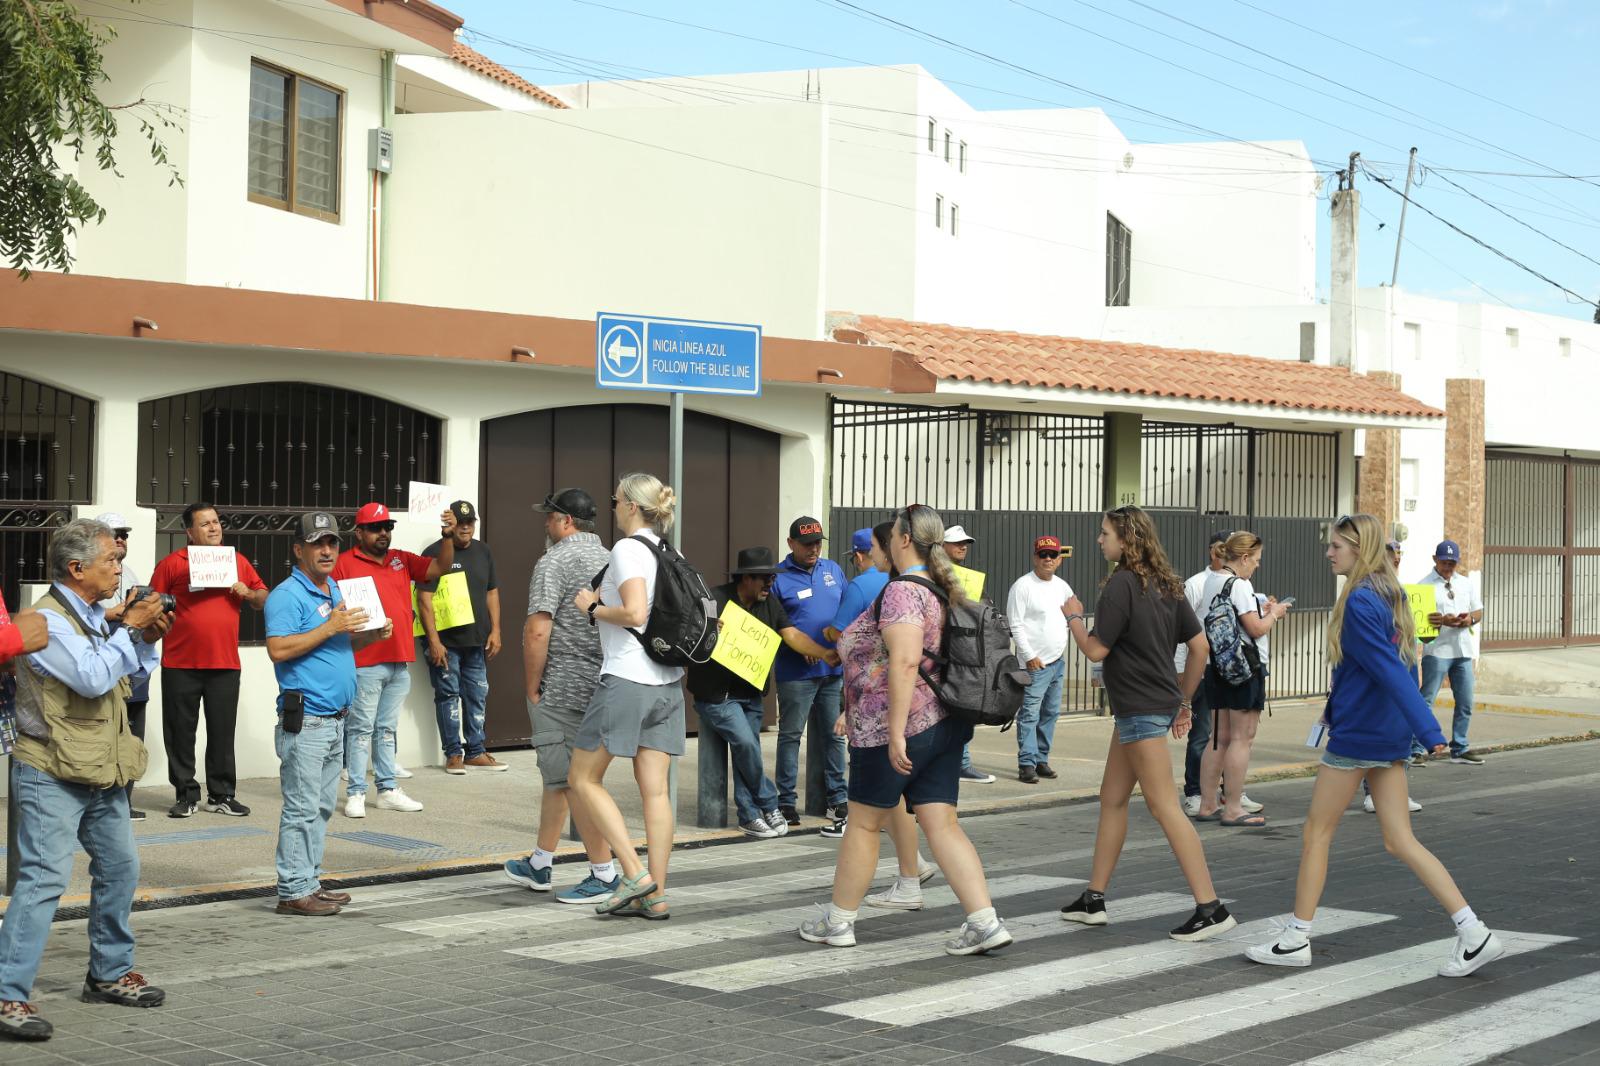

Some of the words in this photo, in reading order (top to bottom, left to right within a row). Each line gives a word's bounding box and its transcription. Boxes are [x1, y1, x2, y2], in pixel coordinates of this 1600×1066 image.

[653, 339, 678, 353] INICIA
[680, 341, 704, 355] LINEA
[705, 344, 727, 357] AZUL
[653, 359, 688, 374] FOLLOW
[690, 362, 706, 375] THE
[709, 363, 730, 377] BLUE
[732, 365, 750, 378] LINE
[741, 617, 769, 648] Leah
[720, 632, 765, 682] Hornby
